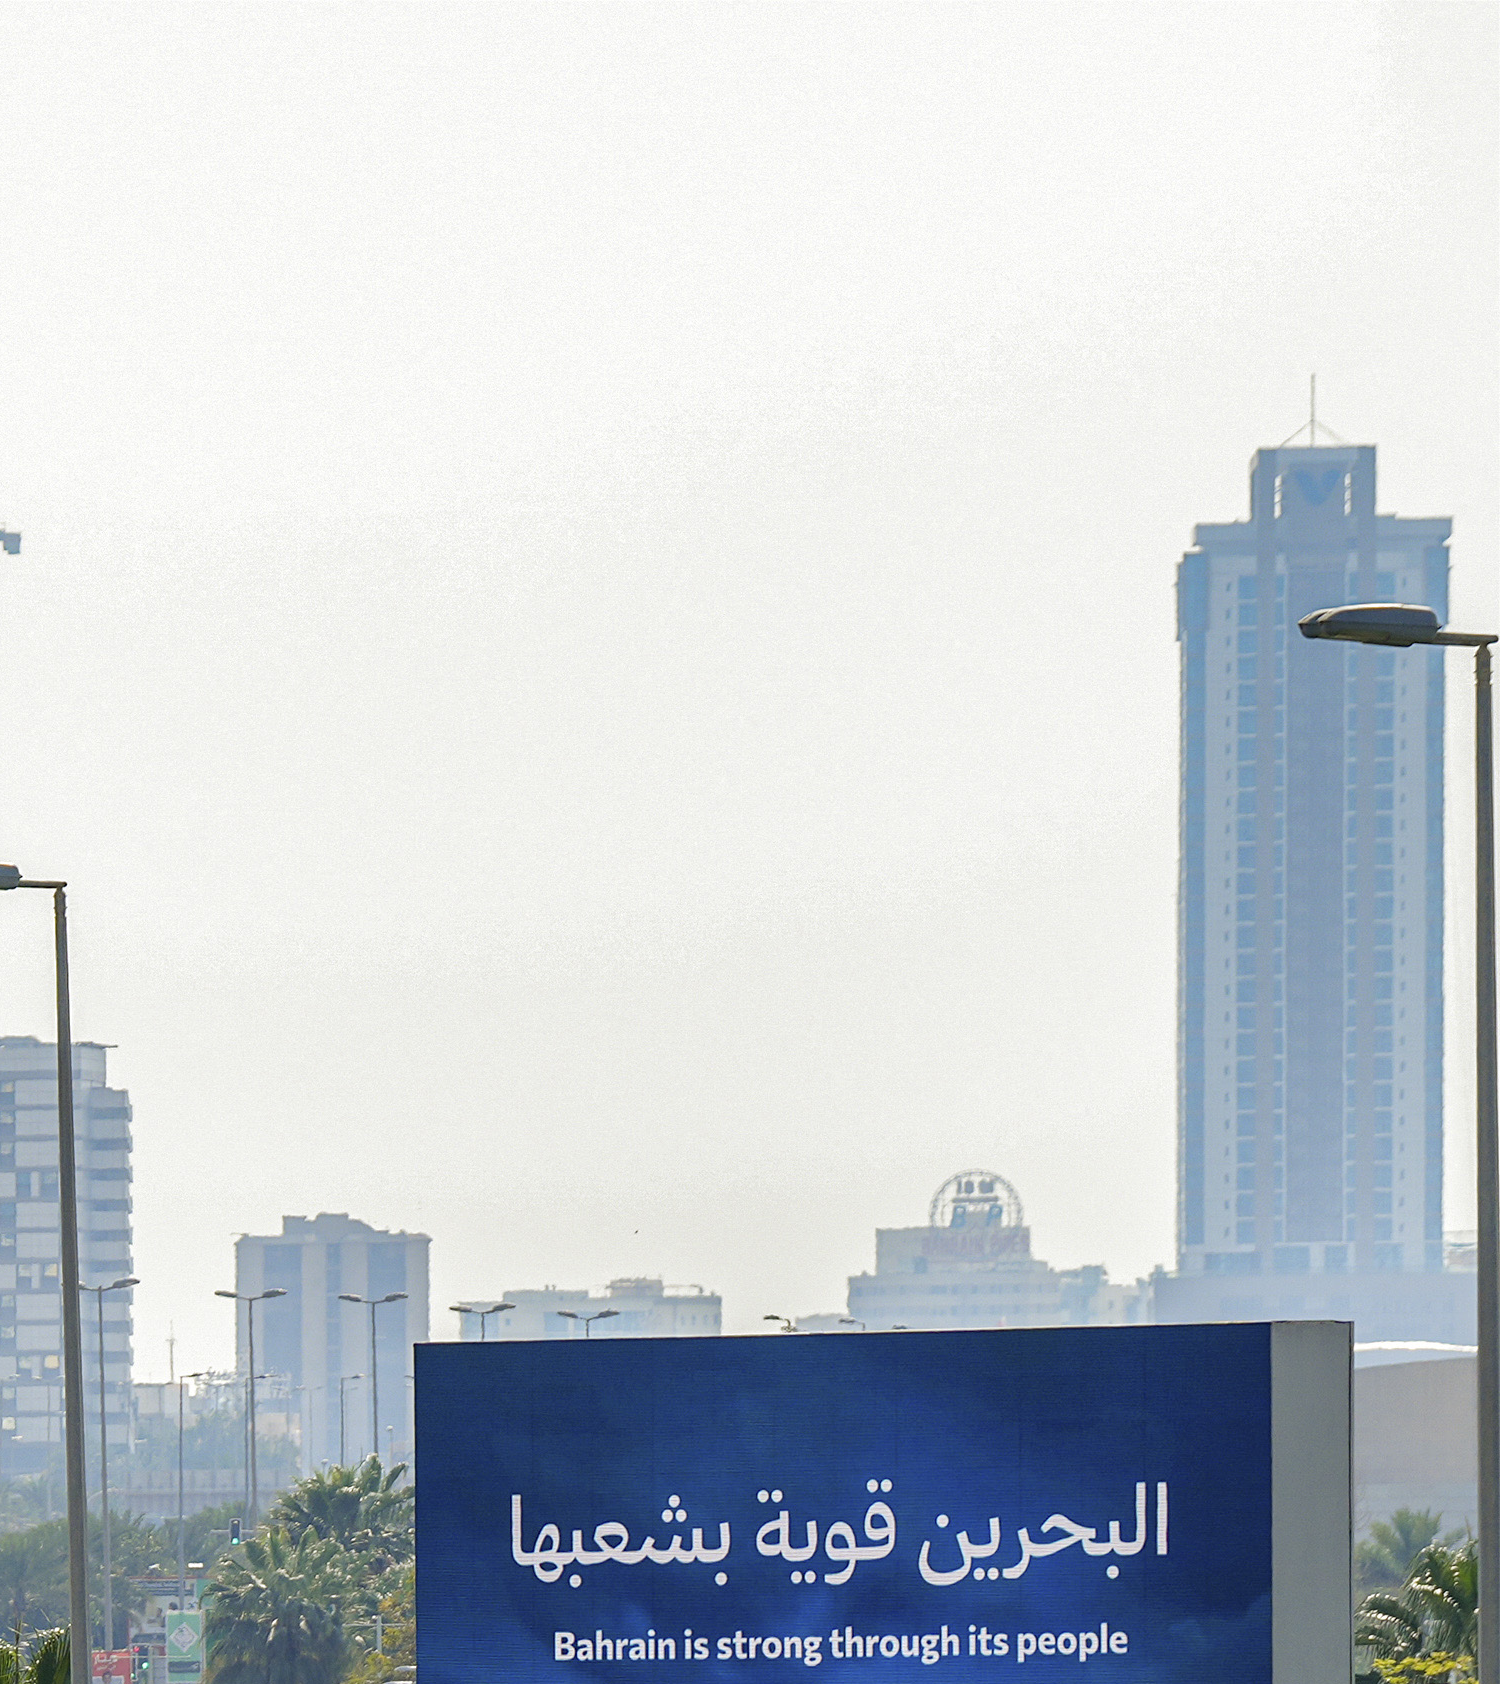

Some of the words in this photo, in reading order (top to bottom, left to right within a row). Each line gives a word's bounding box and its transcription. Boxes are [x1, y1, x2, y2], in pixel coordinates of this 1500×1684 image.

[510, 1493, 731, 1588] بشعبها
[754, 1478, 897, 1586] قوية
[918, 1480, 1169, 1587] البحرين
[554, 1630, 676, 1661] Bahrain
[683, 1628, 709, 1660] is
[716, 1629, 823, 1668] strong
[829, 1624, 960, 1667] through
[968, 1624, 1010, 1656] its
[1016, 1622, 1129, 1664] people
